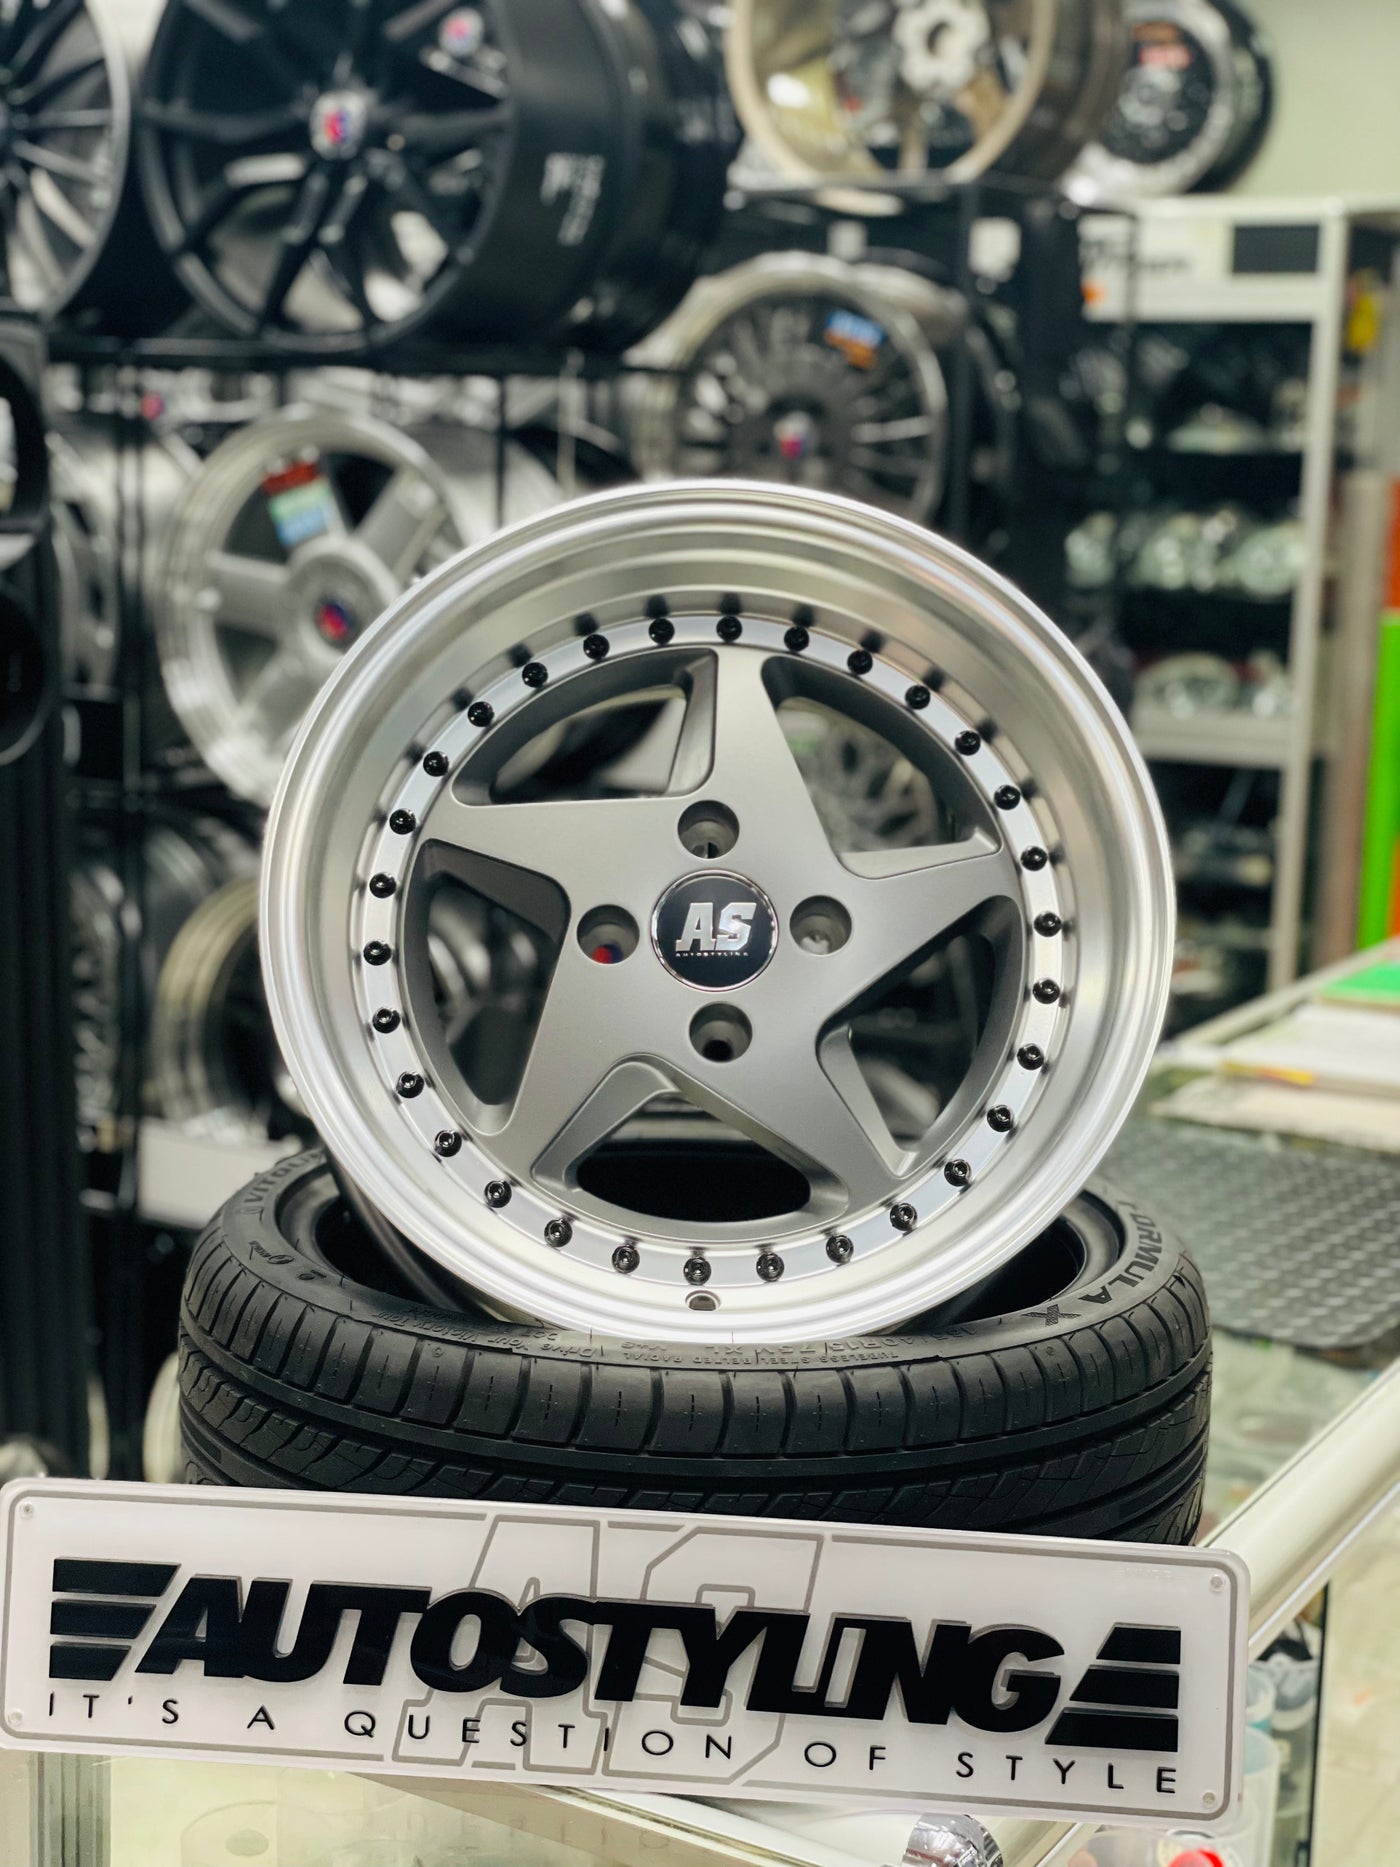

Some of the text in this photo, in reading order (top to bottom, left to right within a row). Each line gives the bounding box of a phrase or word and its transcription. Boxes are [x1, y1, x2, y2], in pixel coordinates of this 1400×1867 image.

[674, 901, 758, 952] AS
[1078, 1200, 1163, 1304] FORMULA
[135, 1574, 1065, 1733] AUTOSTYLING
[48, 1693, 1178, 1794] IT'S A QUESTION OF STYLE
